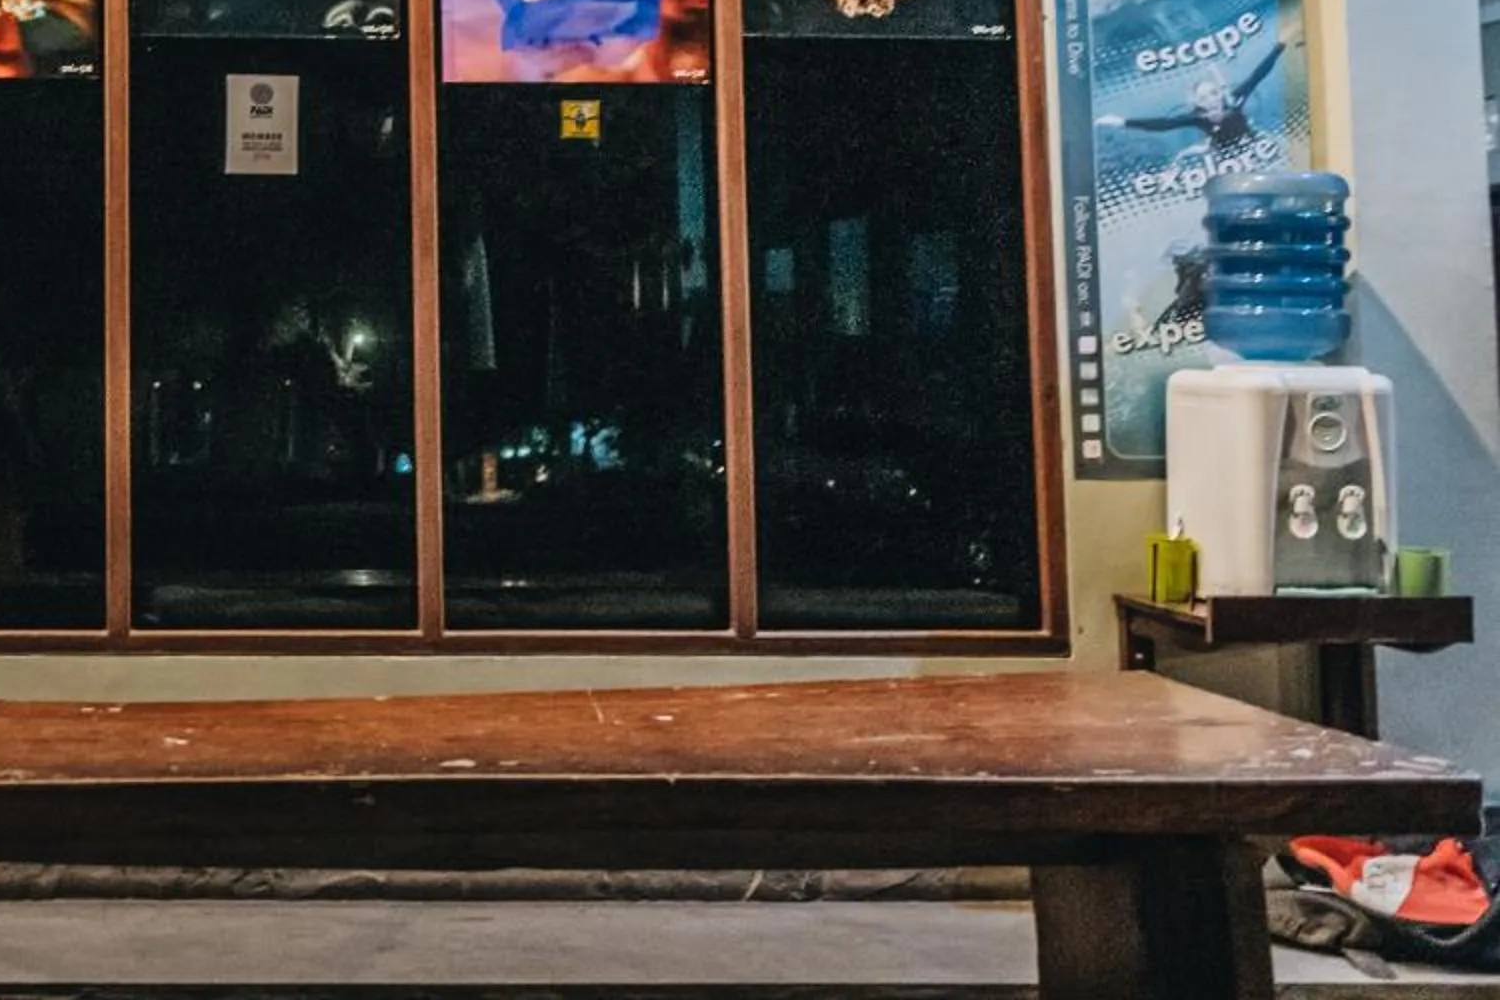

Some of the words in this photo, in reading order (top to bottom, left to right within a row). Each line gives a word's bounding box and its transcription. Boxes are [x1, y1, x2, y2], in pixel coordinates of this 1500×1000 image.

[1066, 23, 1081, 39] to
[1135, 11, 1262, 73] escape
[1075, 245, 1093, 279] PADI
[1113, 317, 1205, 354] expe
